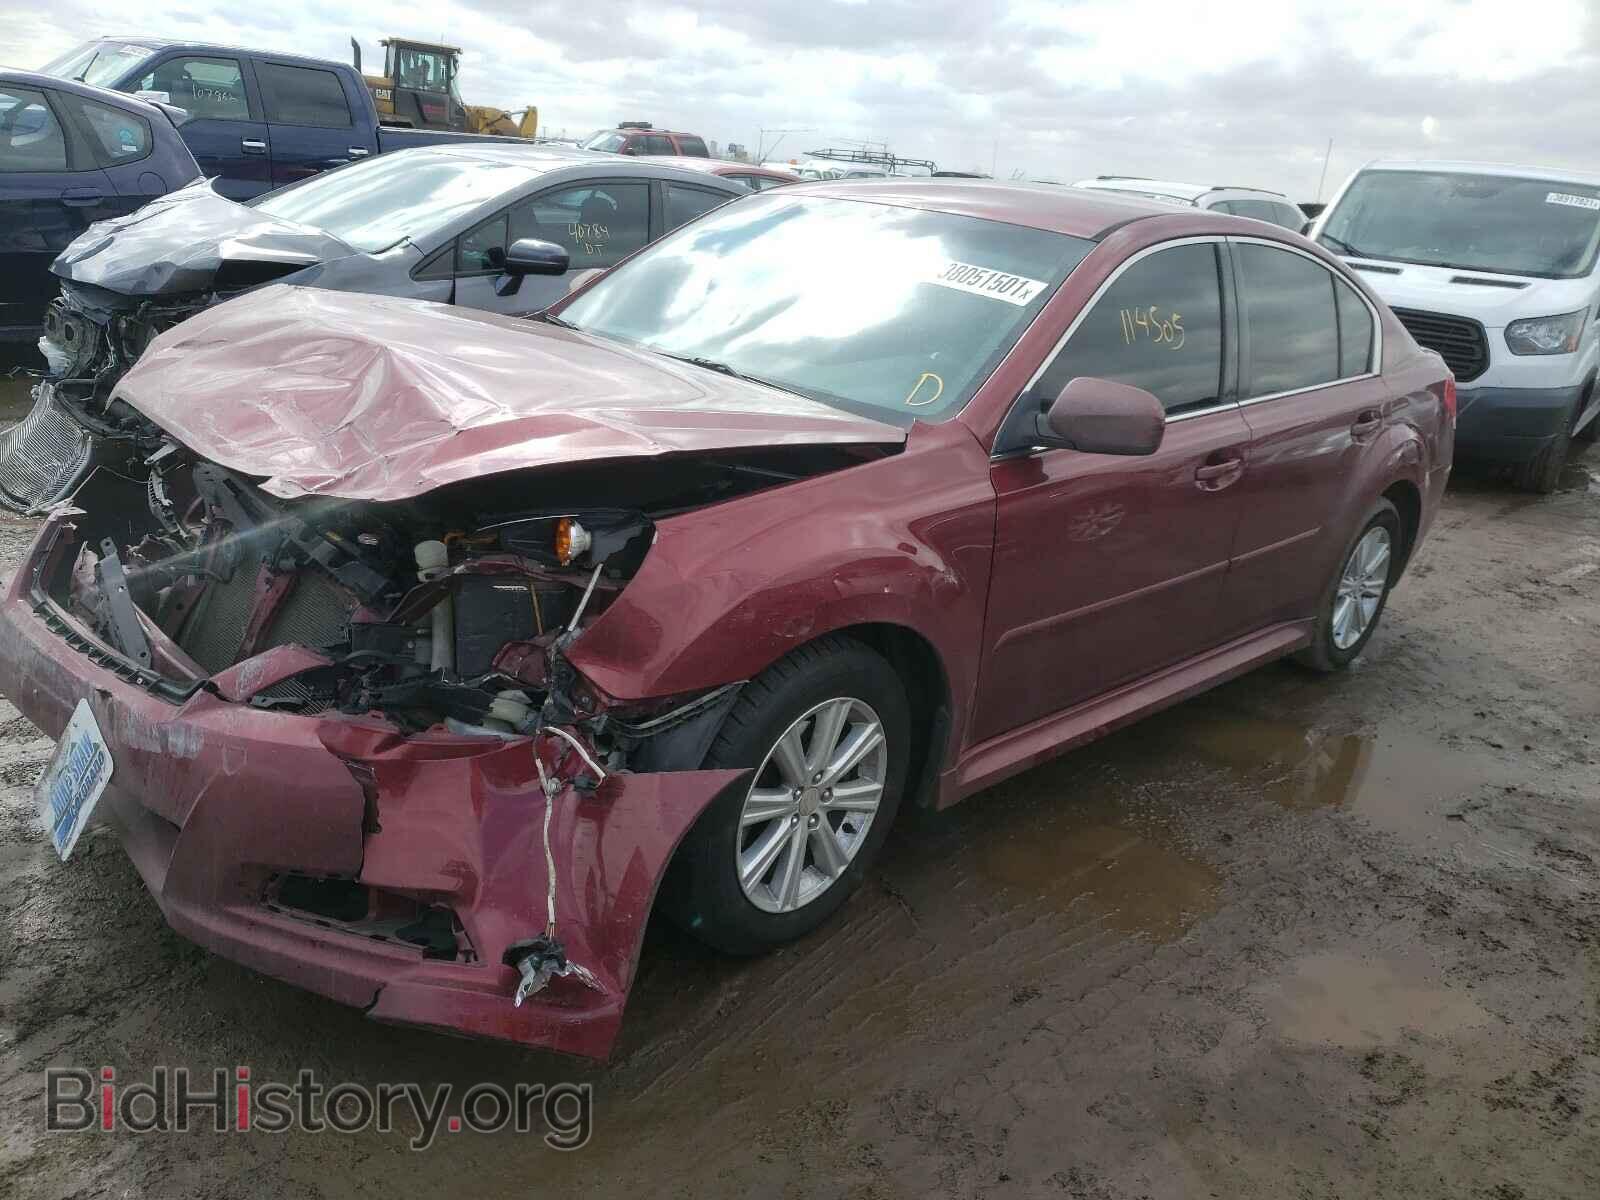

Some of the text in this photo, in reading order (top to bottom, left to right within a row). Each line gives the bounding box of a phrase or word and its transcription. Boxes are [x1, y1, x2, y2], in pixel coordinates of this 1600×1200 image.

[375, 88, 392, 100] CAT
[1120, 306, 1185, 350] 114505
[905, 373, 943, 406] D
